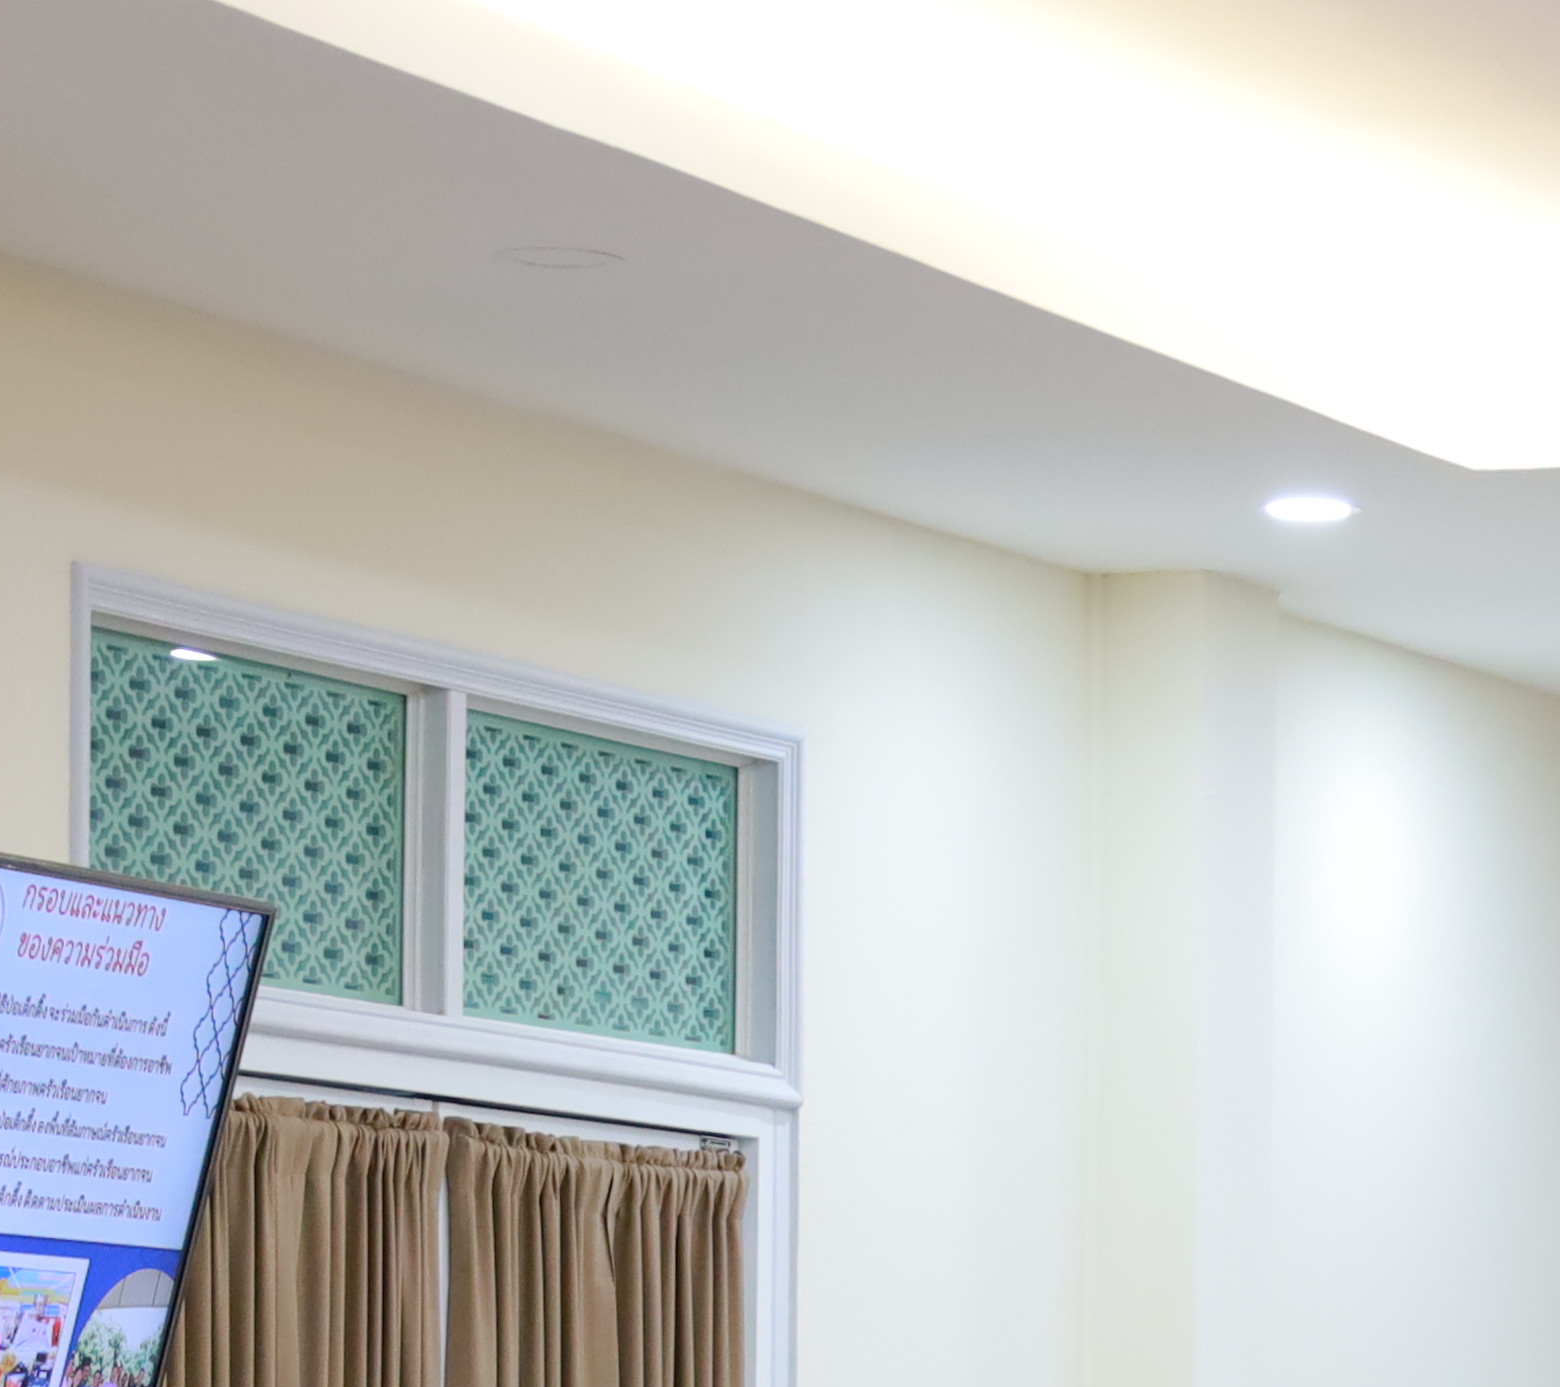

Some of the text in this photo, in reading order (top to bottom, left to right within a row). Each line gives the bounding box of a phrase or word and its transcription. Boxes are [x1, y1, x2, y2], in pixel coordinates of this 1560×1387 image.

[22, 884, 167, 932] กรอบและแนวทาง
[17, 932, 151, 976] ของความร่วมมือ
